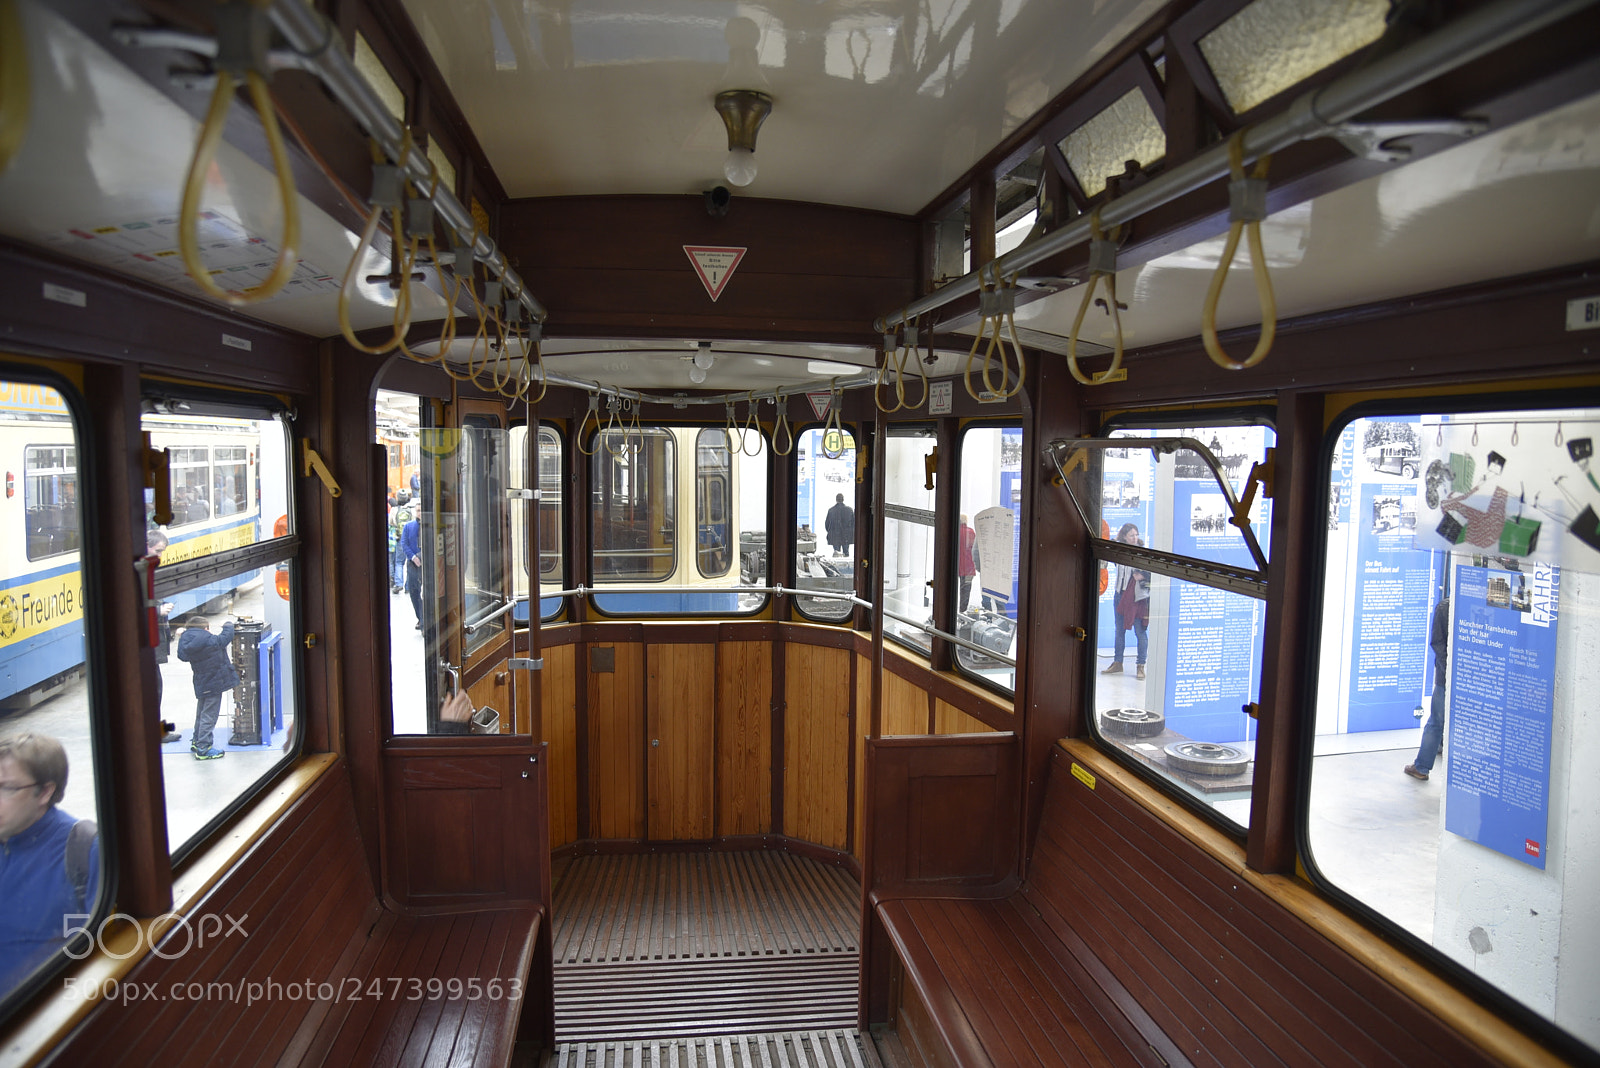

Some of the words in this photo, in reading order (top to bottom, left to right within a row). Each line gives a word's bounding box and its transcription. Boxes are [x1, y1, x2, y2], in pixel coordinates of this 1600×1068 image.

[828, 435, 839, 449] H
[22, 583, 73, 629] Freunde
[1459, 619, 1484, 630] Münchner
[1485, 623, 1518, 636] Trambahnen
[1459, 626, 1468, 634] Von
[1470, 628, 1478, 636] der
[1487, 640, 1504, 649] Under
